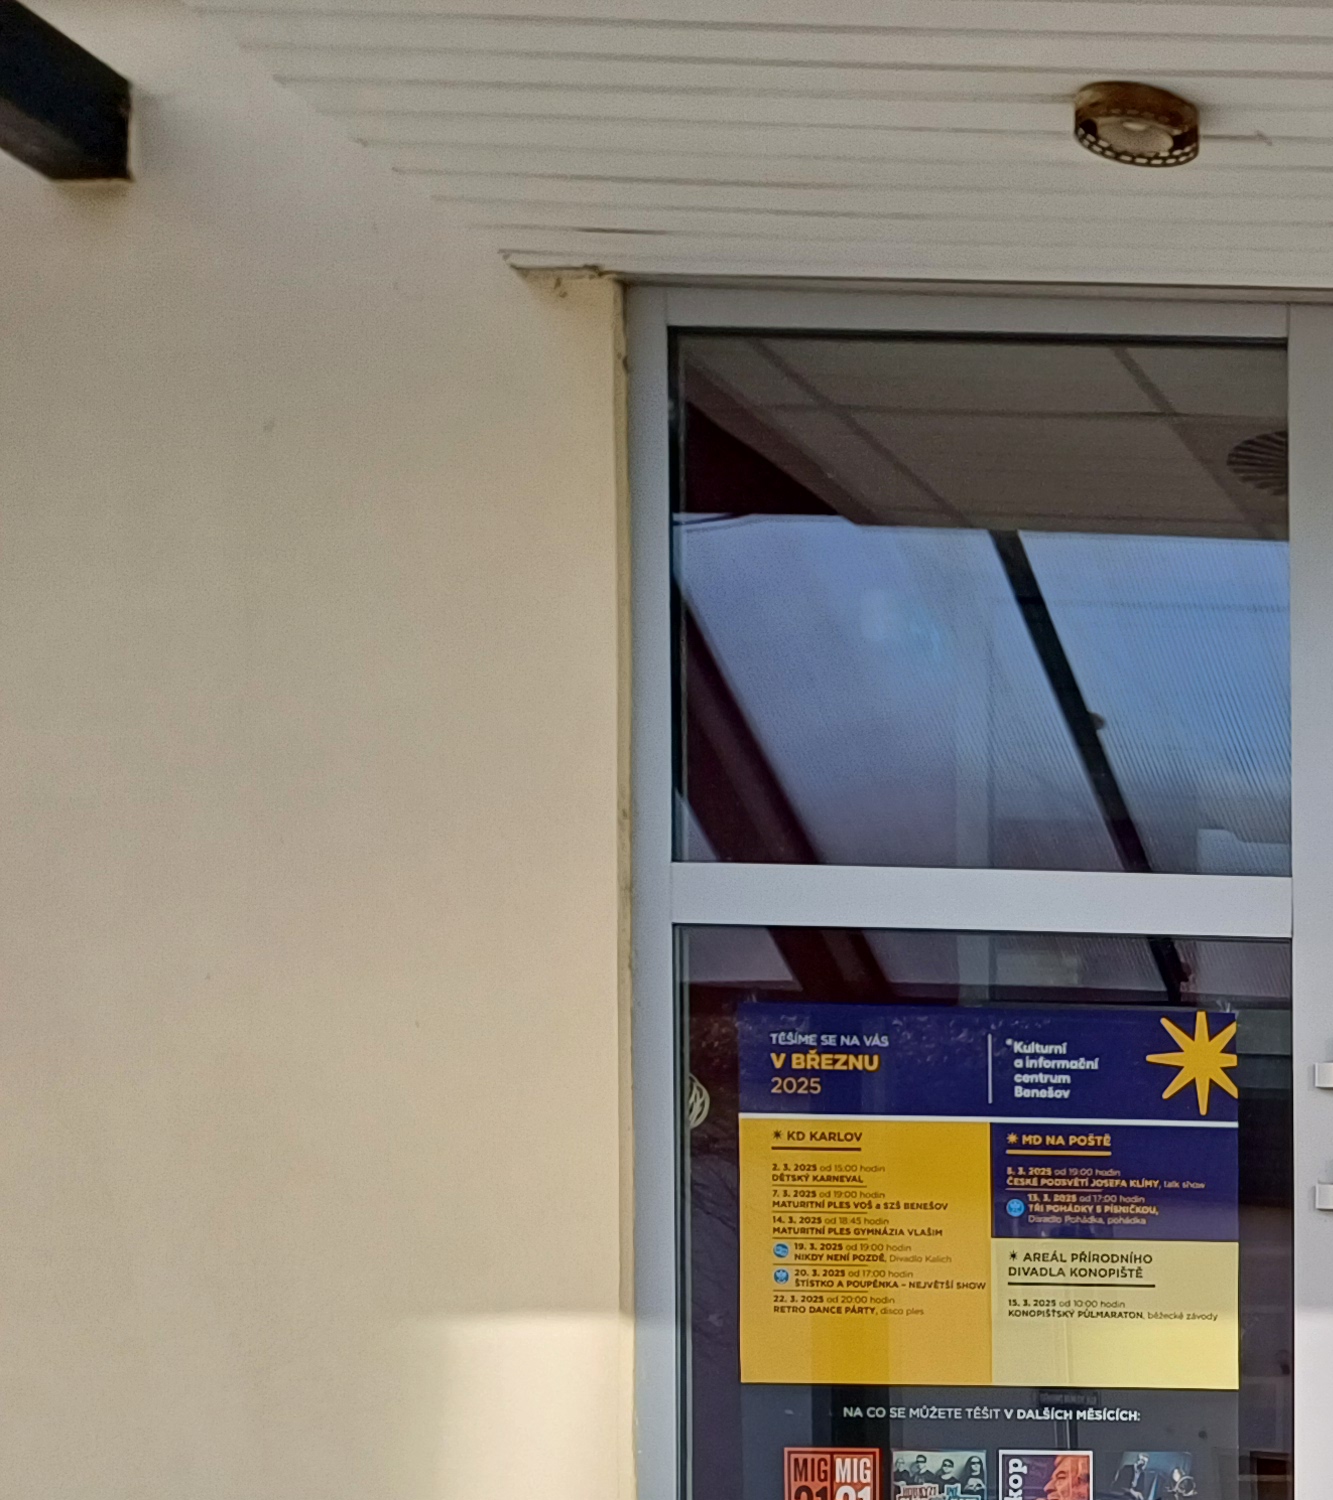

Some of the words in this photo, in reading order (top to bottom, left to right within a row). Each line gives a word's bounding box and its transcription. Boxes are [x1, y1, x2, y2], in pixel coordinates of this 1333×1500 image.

[821, 1035, 837, 1045] SE
[841, 1035, 860, 1046] NA
[863, 1034, 889, 1046] VÁS
[1014, 1042, 1067, 1054] Kulturní
[770, 1053, 786, 1068] V
[792, 1049, 880, 1071] BŘEZNU
[1014, 1059, 1023, 1068] a
[1025, 1057, 1099, 1070] informační
[1014, 1073, 1071, 1084] centrum
[771, 1077, 821, 1094] 2025
[1014, 1086, 1070, 1099] Benešov
[787, 1131, 805, 1141] KD
[810, 1131, 862, 1142] KARLOV
[1022, 1135, 1042, 1145] MD
[1046, 1135, 1065, 1146] NA
[1069, 1134, 1111, 1147] POŠTĚ
[772, 1173, 809, 1182] DĚTSKÝ
[813, 1175, 864, 1183] KARNEVAL
[773, 1200, 825, 1209] MATURITNÍ
[828, 1201, 850, 1209] PLES
[853, 1200, 872, 1210] VOŠ
[884, 1201, 900, 1210] SZŠ
[904, 1201, 948, 1210] BENEŠOV
[773, 1226, 825, 1234] MATURITNÍ
[828, 1227, 851, 1235] PLES
[854, 1226, 904, 1236] GYMNÁZIA
[907, 1227, 943, 1236] VLAŠIM
[794, 1253, 824, 1262] NIKDY
[827, 1253, 850, 1262] NENÍ
[890, 1254, 922, 1262] Divadlo
[1023, 1252, 1067, 1263] AREÁL
[1071, 1252, 1153, 1264] PŘÍRODNÍHO
[1008, 1267, 1065, 1277] DIVADLA
[1070, 1266, 1143, 1278] KONOPIŠTĚ
[795, 1279, 834, 1288] ŠTÍSTKO
[909, 1280, 953, 1289] NEJVĚTŠÍ
[1023, 1299, 1030, 1307] 3.
[1033, 1299, 1056, 1307] 2025
[1101, 1300, 1125, 1308] hodin
[809, 1306, 842, 1314] DANCE
[906, 1307, 924, 1316] ples
[843, 1407, 862, 1418] NA
[867, 1407, 885, 1418] CO
[890, 1408, 905, 1418] SE
[909, 1405, 962, 1419] MŮŽETE
[966, 1406, 1001, 1419] TĚŠIT
[1004, 1409, 1012, 1418] V
[1017, 1407, 1072, 1420] DALŠÍCH
[1076, 1407, 1140, 1421] MĚSÍCÍCH:
[794, 1457, 828, 1482] MIG
[835, 1457, 871, 1483] MIG
